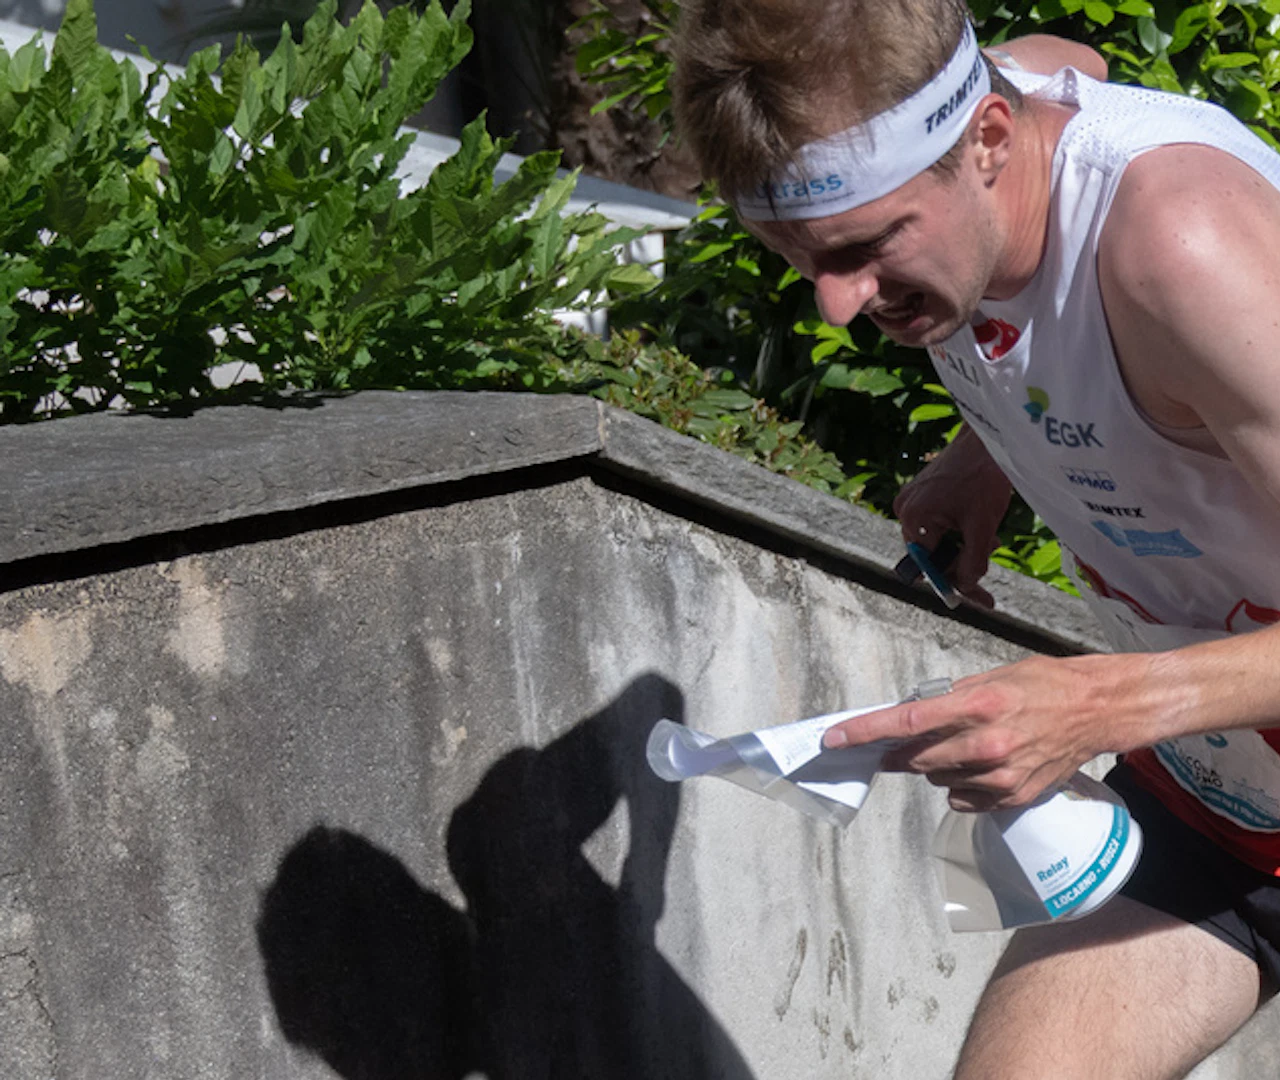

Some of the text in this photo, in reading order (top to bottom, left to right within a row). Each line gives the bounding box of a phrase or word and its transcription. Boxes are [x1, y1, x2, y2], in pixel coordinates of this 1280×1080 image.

[925, 55, 982, 134] TRIMTE
[1045, 416, 1104, 448] EGK
[1065, 472, 1118, 493] KPMG
[1036, 856, 1069, 882] Relay
[1052, 870, 1098, 909] LOCARNO
[1098, 837, 1121, 870] RUSCA
